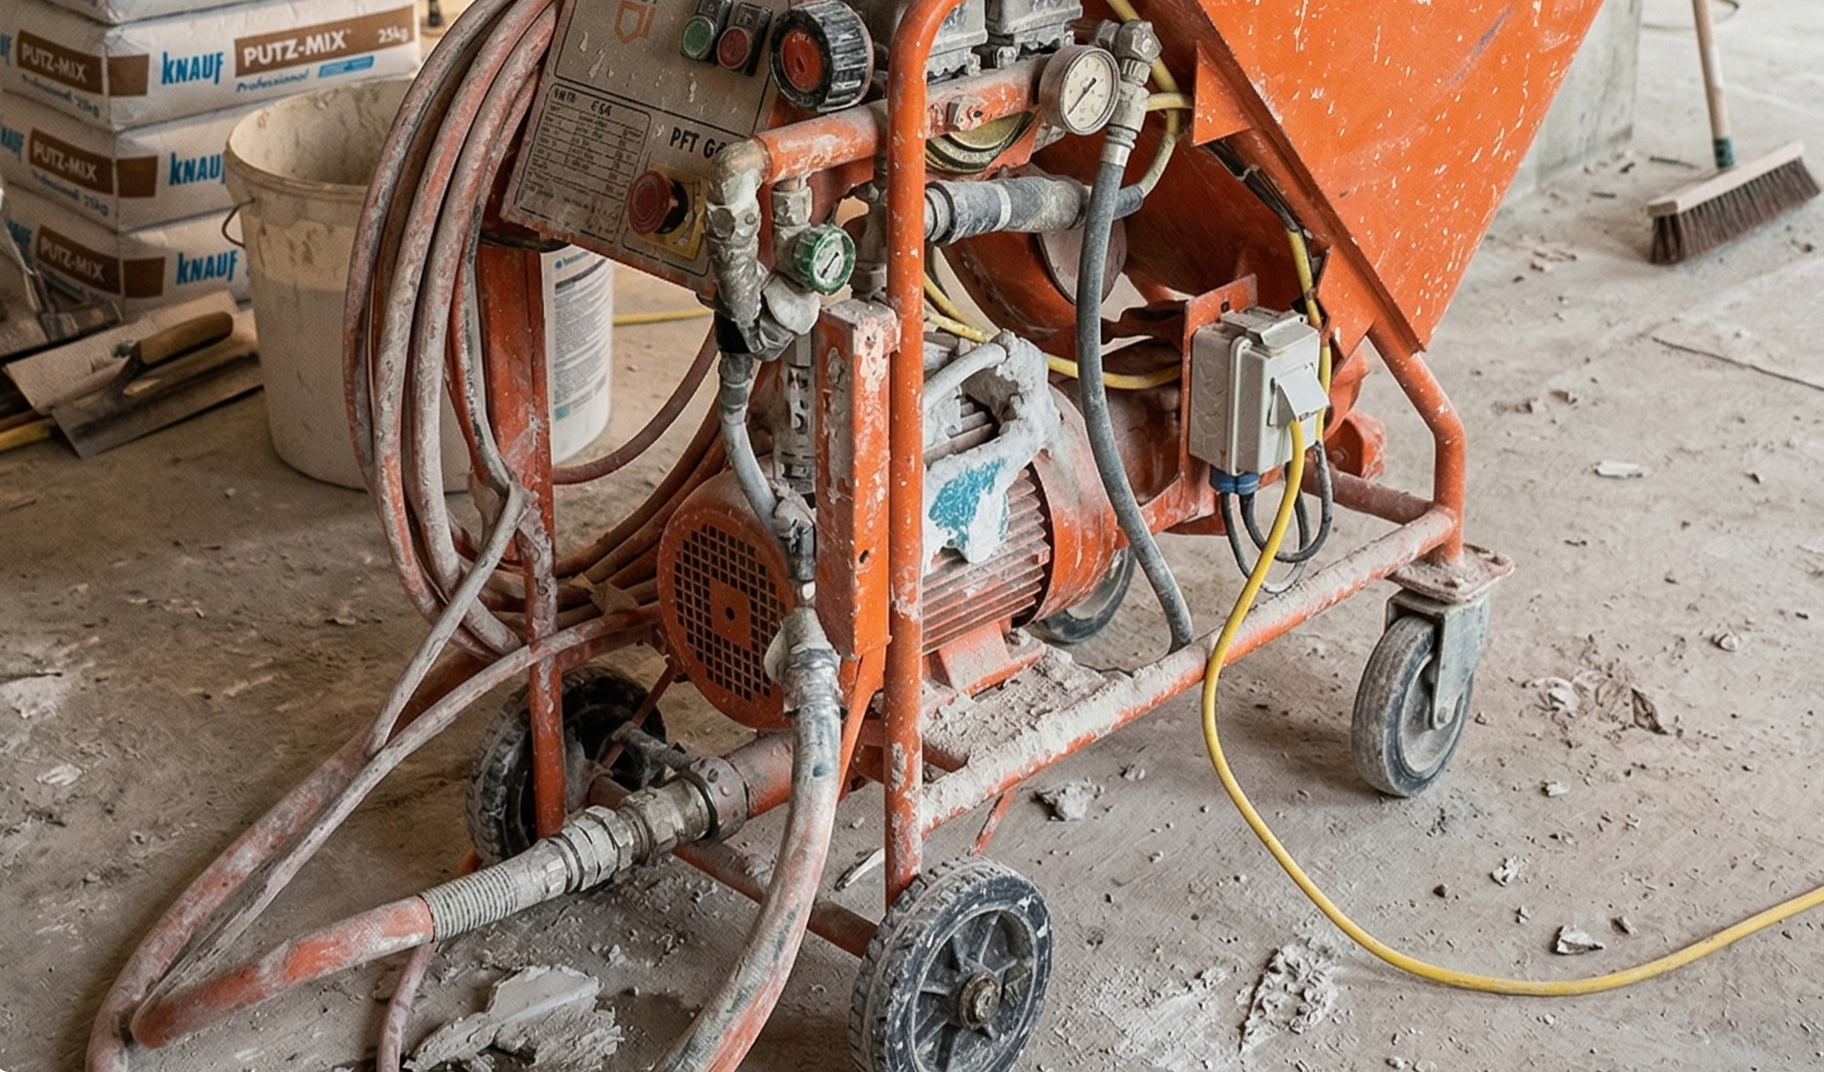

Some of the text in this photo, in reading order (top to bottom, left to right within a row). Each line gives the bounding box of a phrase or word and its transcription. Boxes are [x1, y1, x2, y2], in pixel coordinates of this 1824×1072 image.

[22, 42, 87, 83] PUTZ-MIX
[243, 29, 347, 68] PUTZ-MIX
[161, 50, 224, 86] KNAUF
[669, 126, 700, 154] PFT
[33, 139, 98, 182] PUTZ-MIX
[176, 251, 238, 285] KNAUF
